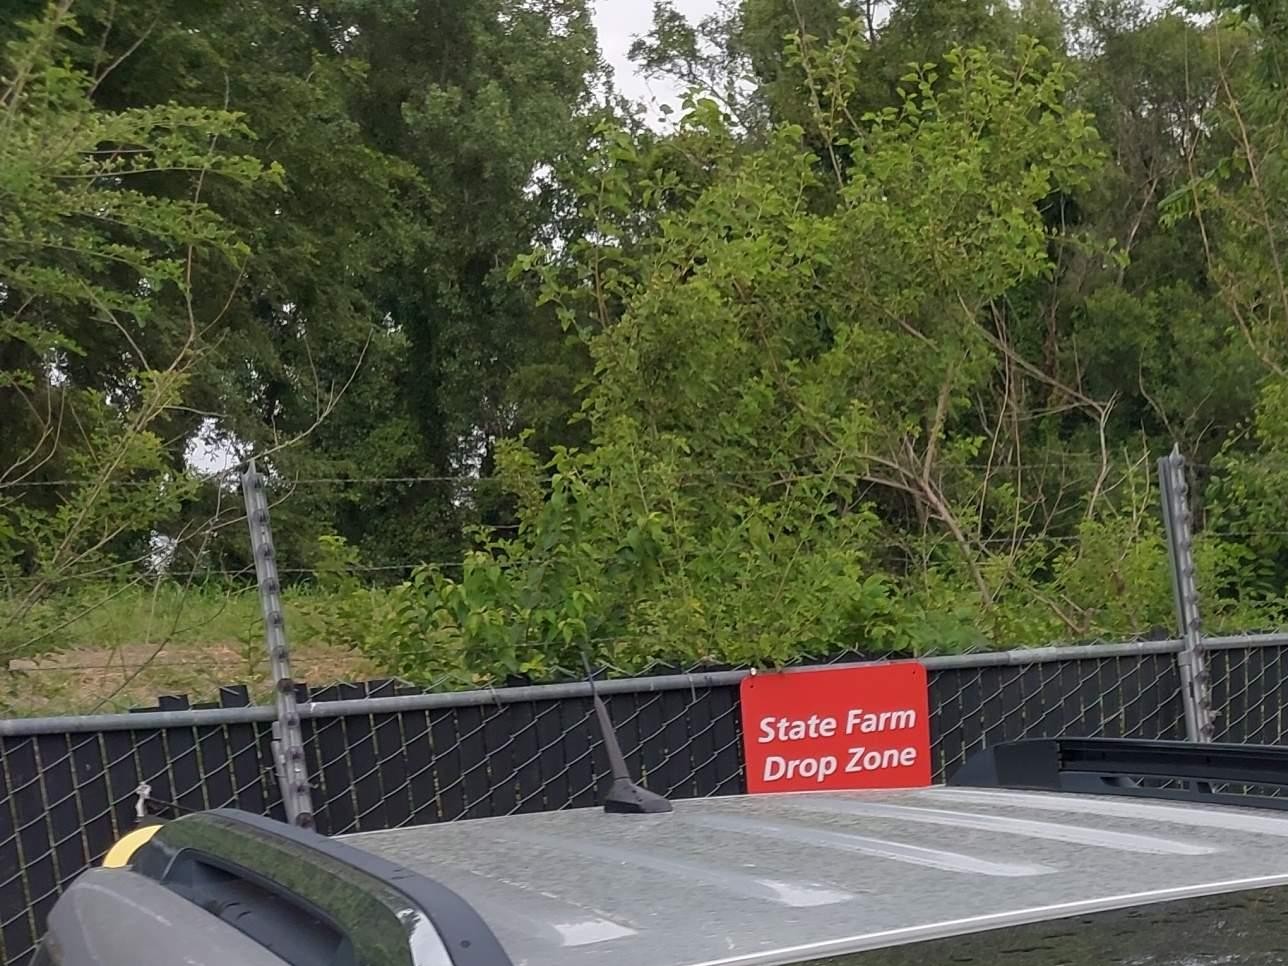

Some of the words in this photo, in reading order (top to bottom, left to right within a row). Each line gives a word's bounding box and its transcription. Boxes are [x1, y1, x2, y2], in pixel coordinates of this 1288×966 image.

[758, 714, 837, 743] State
[845, 709, 916, 735] Farm
[763, 755, 838, 782] Drop
[844, 746, 917, 773] Zone
